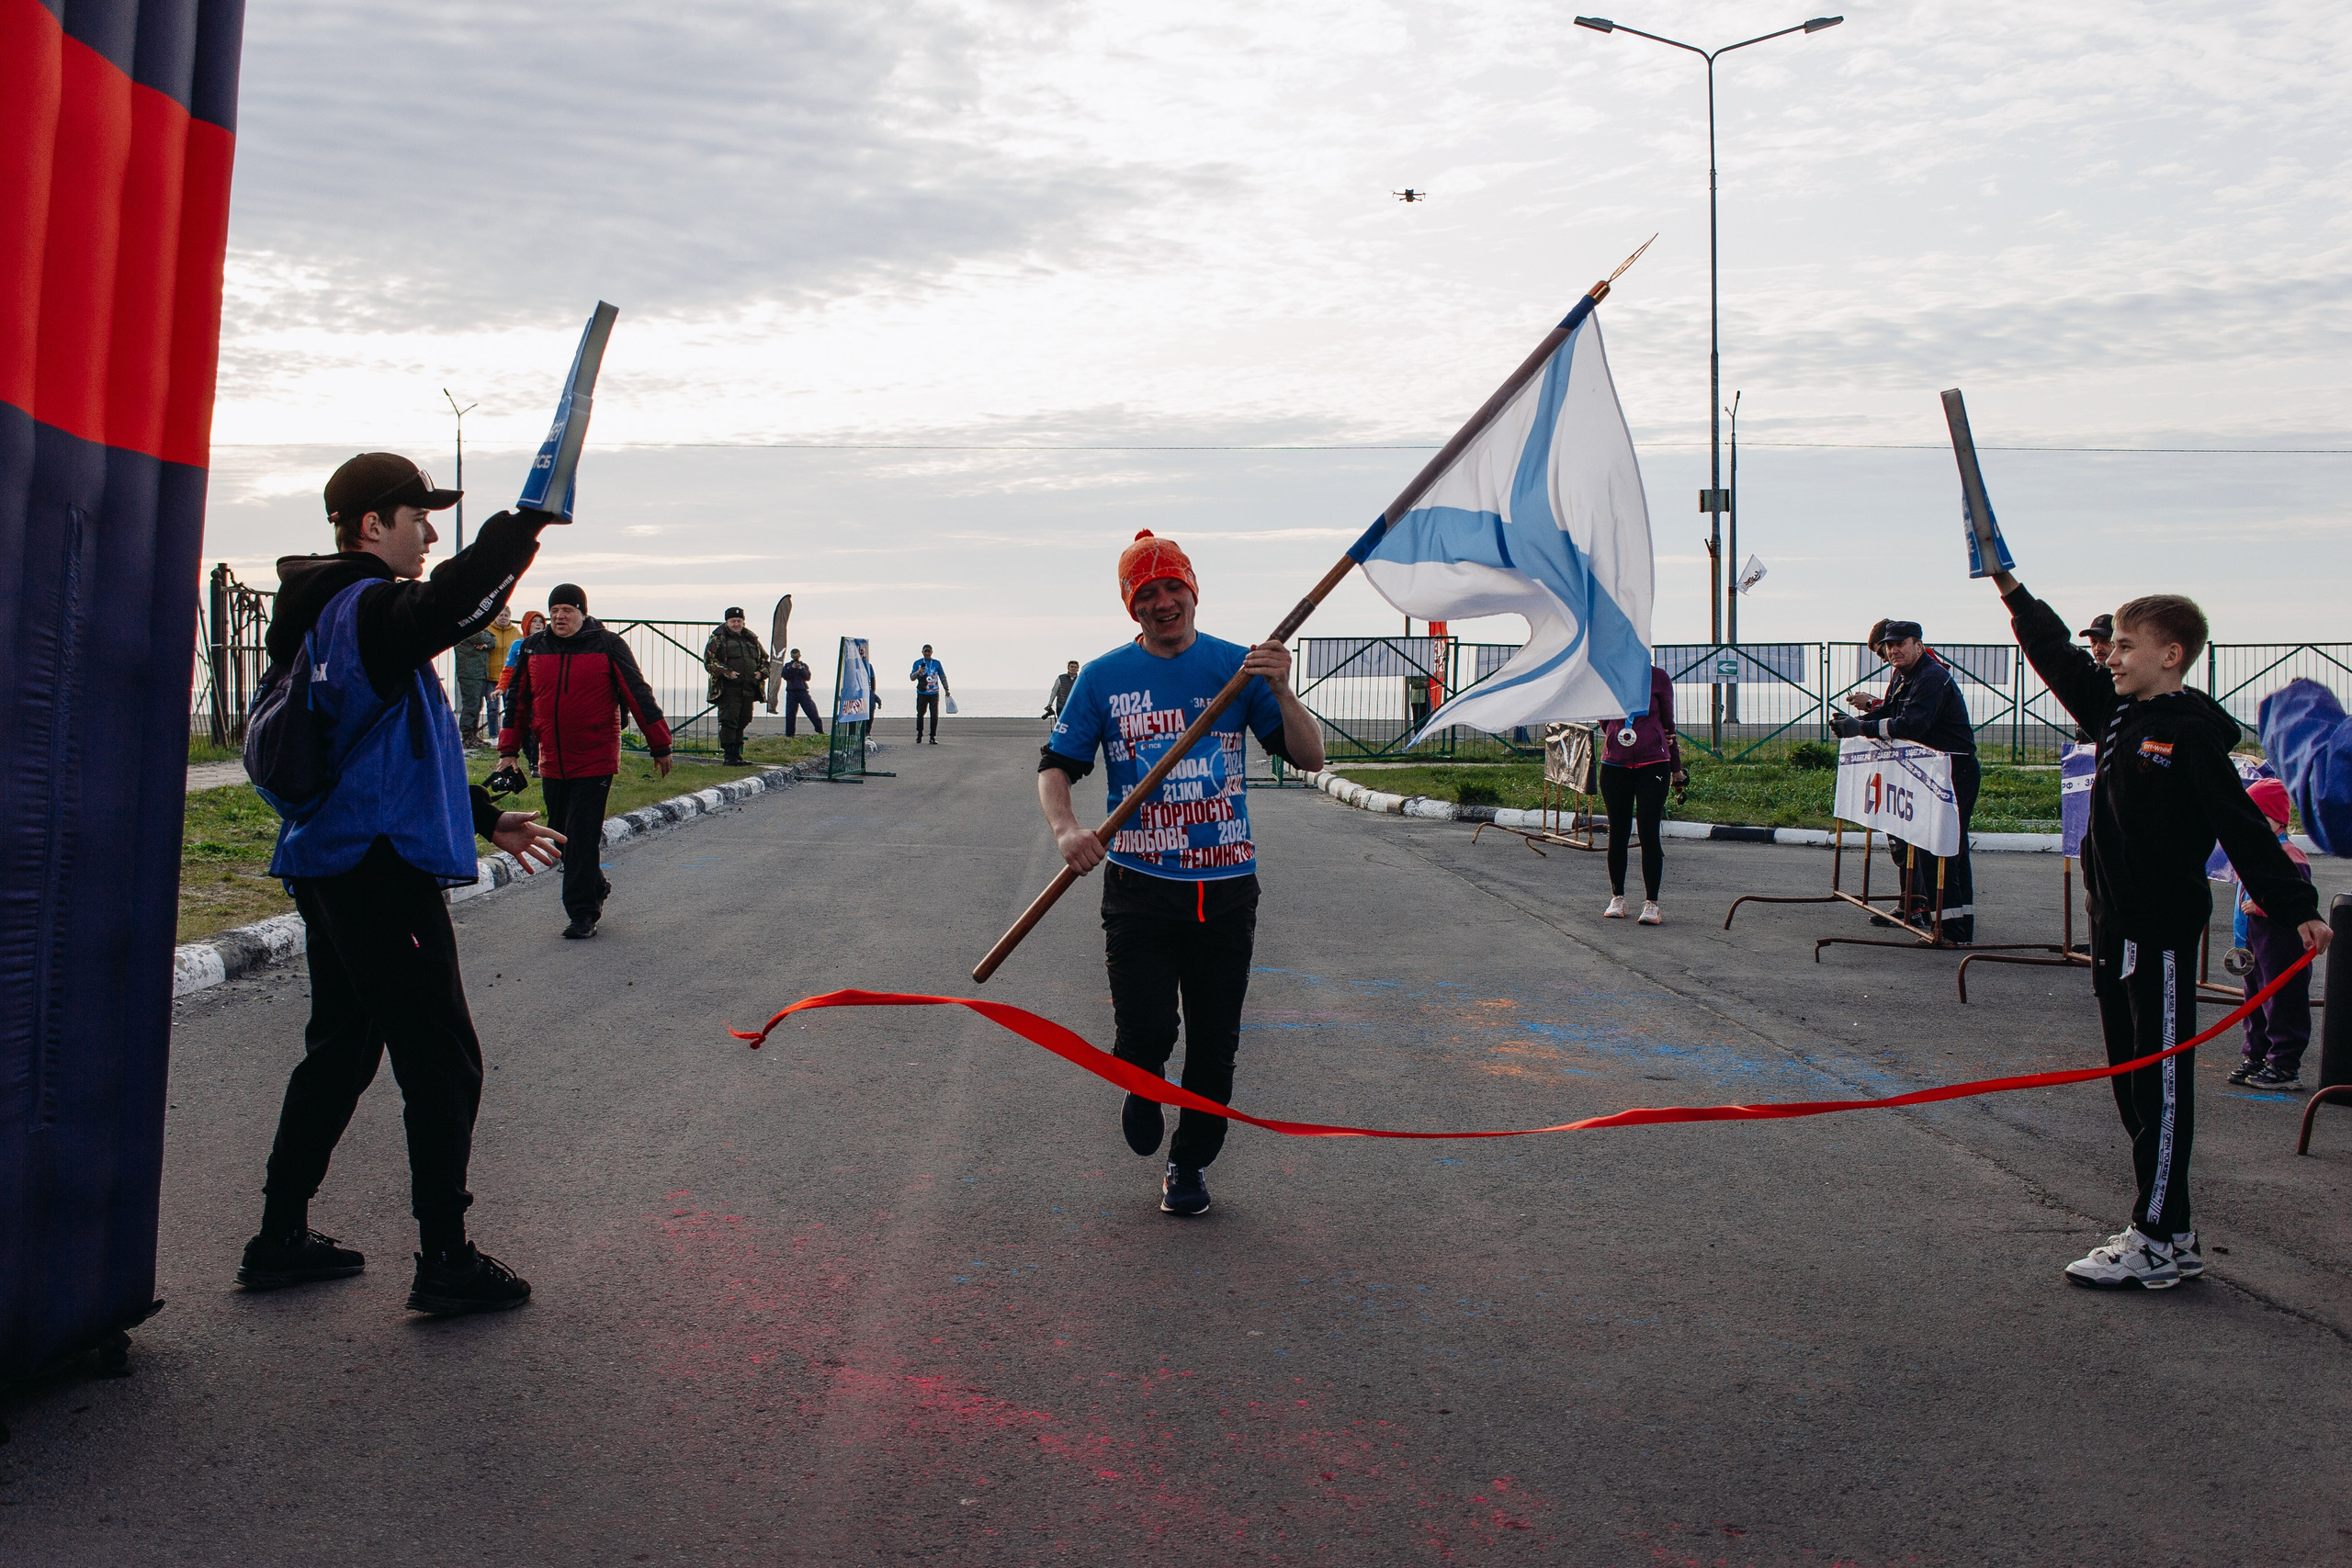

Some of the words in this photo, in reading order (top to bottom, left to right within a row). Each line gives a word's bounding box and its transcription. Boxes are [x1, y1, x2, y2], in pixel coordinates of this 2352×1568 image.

[1109, 690, 1153, 717] 2024
[1119, 708, 1186, 739] #МЕЧТА
[1223, 750, 1244, 776] 2024
[1141, 797, 1235, 829] #ГОРДОСТЬ
[1886, 783, 1914, 822] ПСБ
[1114, 828, 1189, 852] #ЛЮБОВЬ
[1218, 818, 1247, 844] 2024
[2161, 1152, 2170, 1180] YOURSELF
